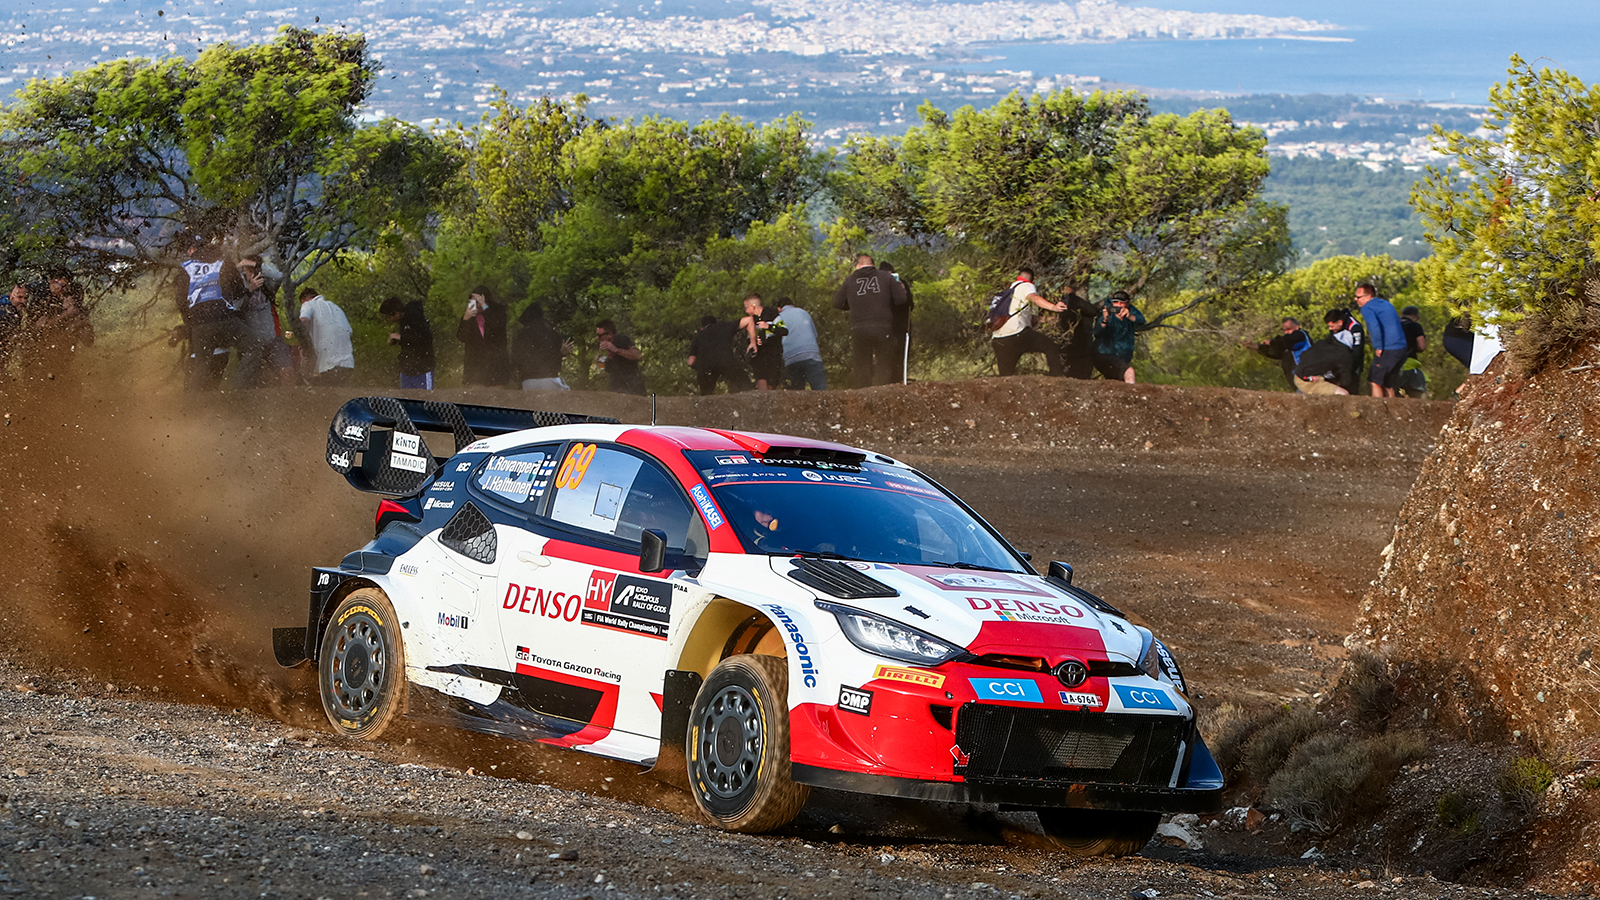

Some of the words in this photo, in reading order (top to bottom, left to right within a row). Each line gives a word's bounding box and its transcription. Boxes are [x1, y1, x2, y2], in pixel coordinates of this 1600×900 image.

[194, 265, 209, 275] 20
[856, 276, 880, 295] 74
[393, 456, 425, 469] TAMADIC
[555, 442, 597, 490] 69
[751, 458, 814, 466] TOYOTA
[822, 473, 872, 485] WRC
[692, 486, 722, 527] AsahiKASEI
[400, 564, 418, 575] ENDLESS
[587, 578, 613, 602] HY
[674, 584, 687, 592] PIAA
[503, 582, 581, 622] DENSO
[633, 601, 646, 610] RALLY
[634, 594, 659, 603] ACROPOLIS
[338, 605, 383, 626] SCORPION
[965, 597, 1084, 618] DENSO
[437, 612, 461, 628] Mobil
[596, 615, 604, 623] FIA
[605, 616, 617, 625] World
[617, 619, 629, 629] Rally
[629, 622, 658, 634] Championship
[1015, 612, 1071, 625] Microsoft
[762, 603, 819, 688] Panasonic
[531, 654, 562, 668] TOYOTA
[563, 662, 593, 675] GAZOO
[593, 668, 622, 682] Racing
[878, 667, 939, 685] PIRELLI
[840, 692, 870, 709] OMP
[1069, 695, 1096, 704] A-6764
